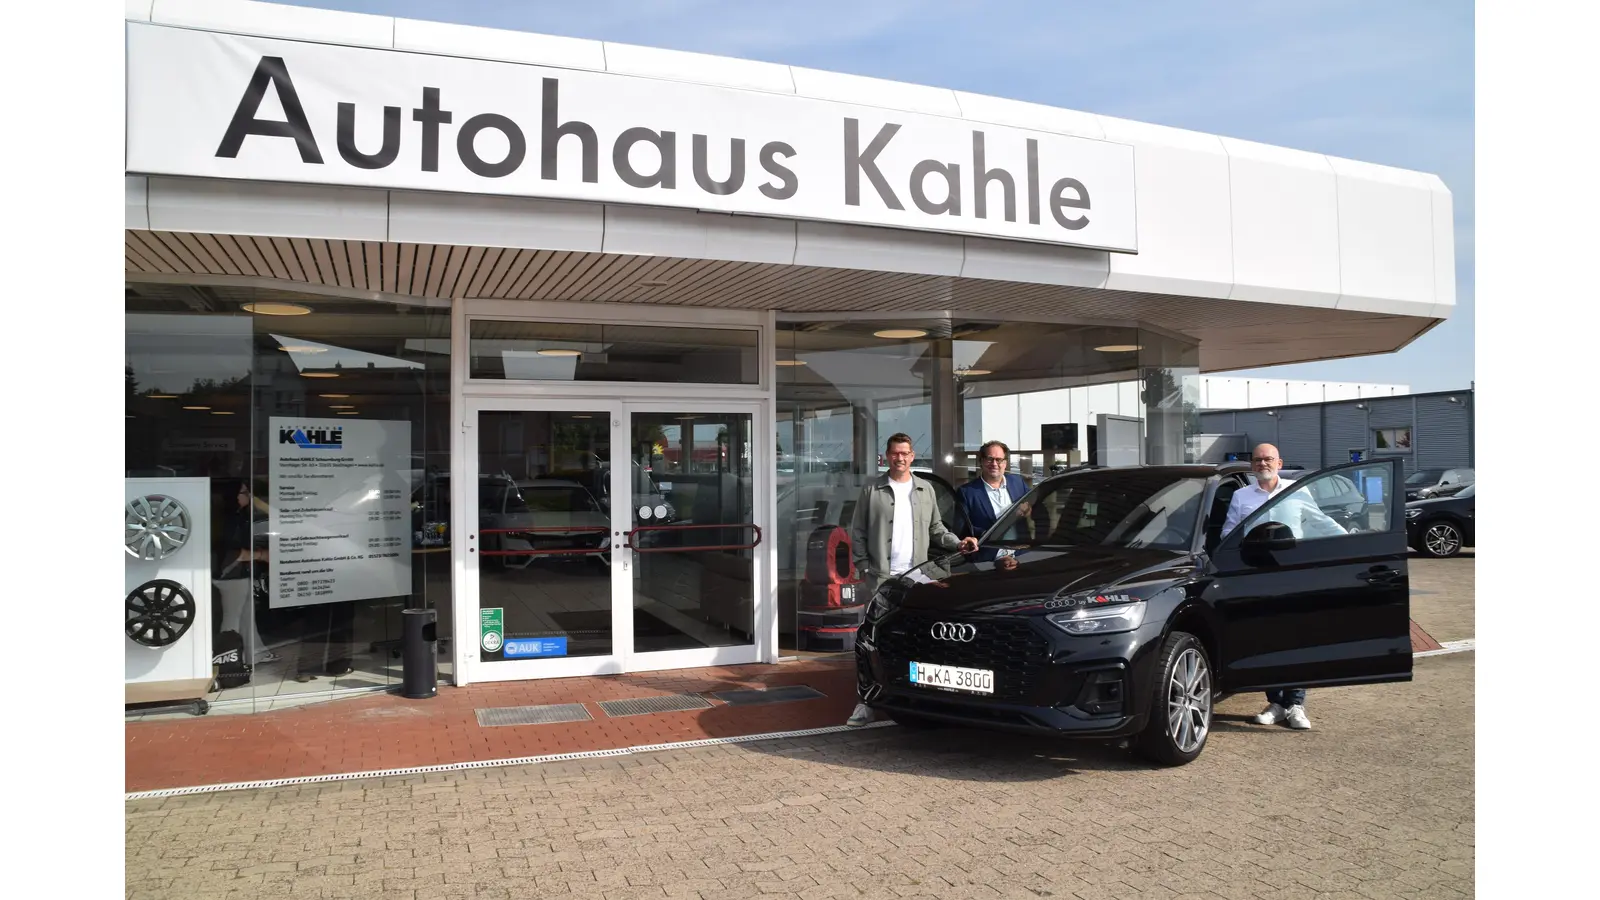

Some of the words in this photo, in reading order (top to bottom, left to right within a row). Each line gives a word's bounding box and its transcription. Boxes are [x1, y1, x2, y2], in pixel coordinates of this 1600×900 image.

[215, 56, 798, 200] Autohaus
[843, 118, 1092, 231] Kahle
[279, 429, 342, 445] KAHLE
[1086, 594, 1130, 604] KAHLE
[518, 643, 540, 653] AUK
[917, 665, 926, 682] H
[934, 668, 952, 685] KA
[956, 670, 991, 690] 3800
